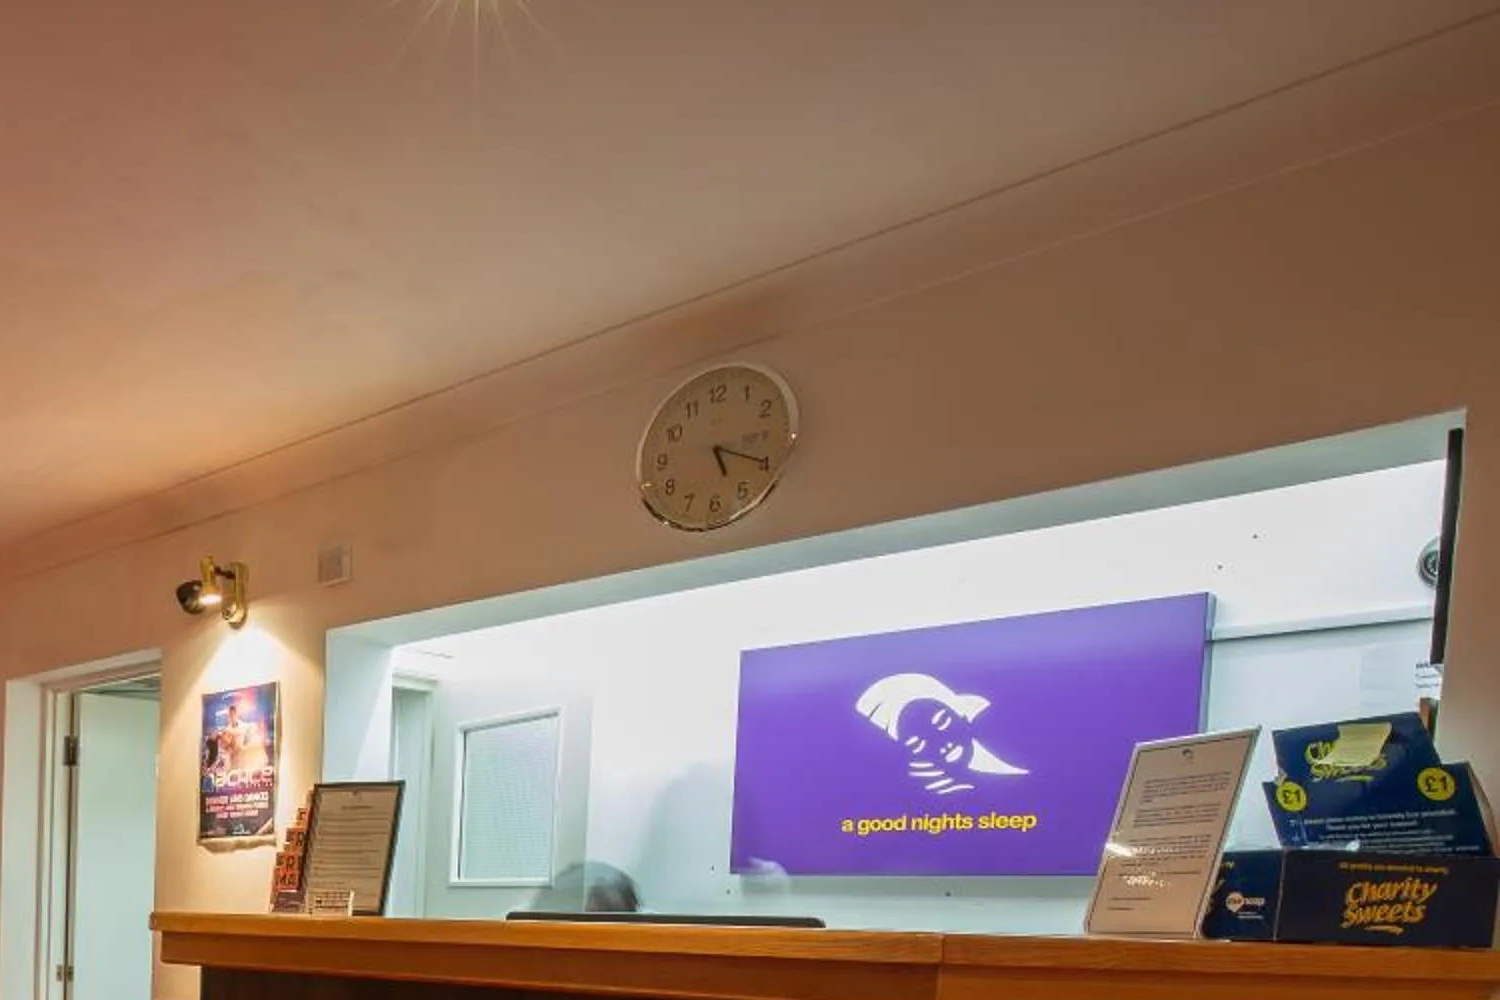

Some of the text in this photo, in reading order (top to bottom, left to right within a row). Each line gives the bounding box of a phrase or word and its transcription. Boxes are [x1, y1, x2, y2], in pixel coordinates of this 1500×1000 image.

[709, 384, 727, 403] 12
[744, 385, 750, 402] 1
[686, 401, 699, 419] 11
[758, 399, 772, 418] 2
[667, 424, 683, 443] 10
[657, 453, 668, 471] 9
[664, 479, 675, 496] 8
[737, 482, 750, 500] 5
[684, 494, 695, 512] 7
[709, 495, 721, 513] 6
[1425, 775, 1448, 793] £1
[1281, 788, 1302, 805] £1
[841, 810, 1038, 836] a good nights sleep
[1347, 876, 1438, 905] Charity
[1339, 899, 1427, 929] Sweets
